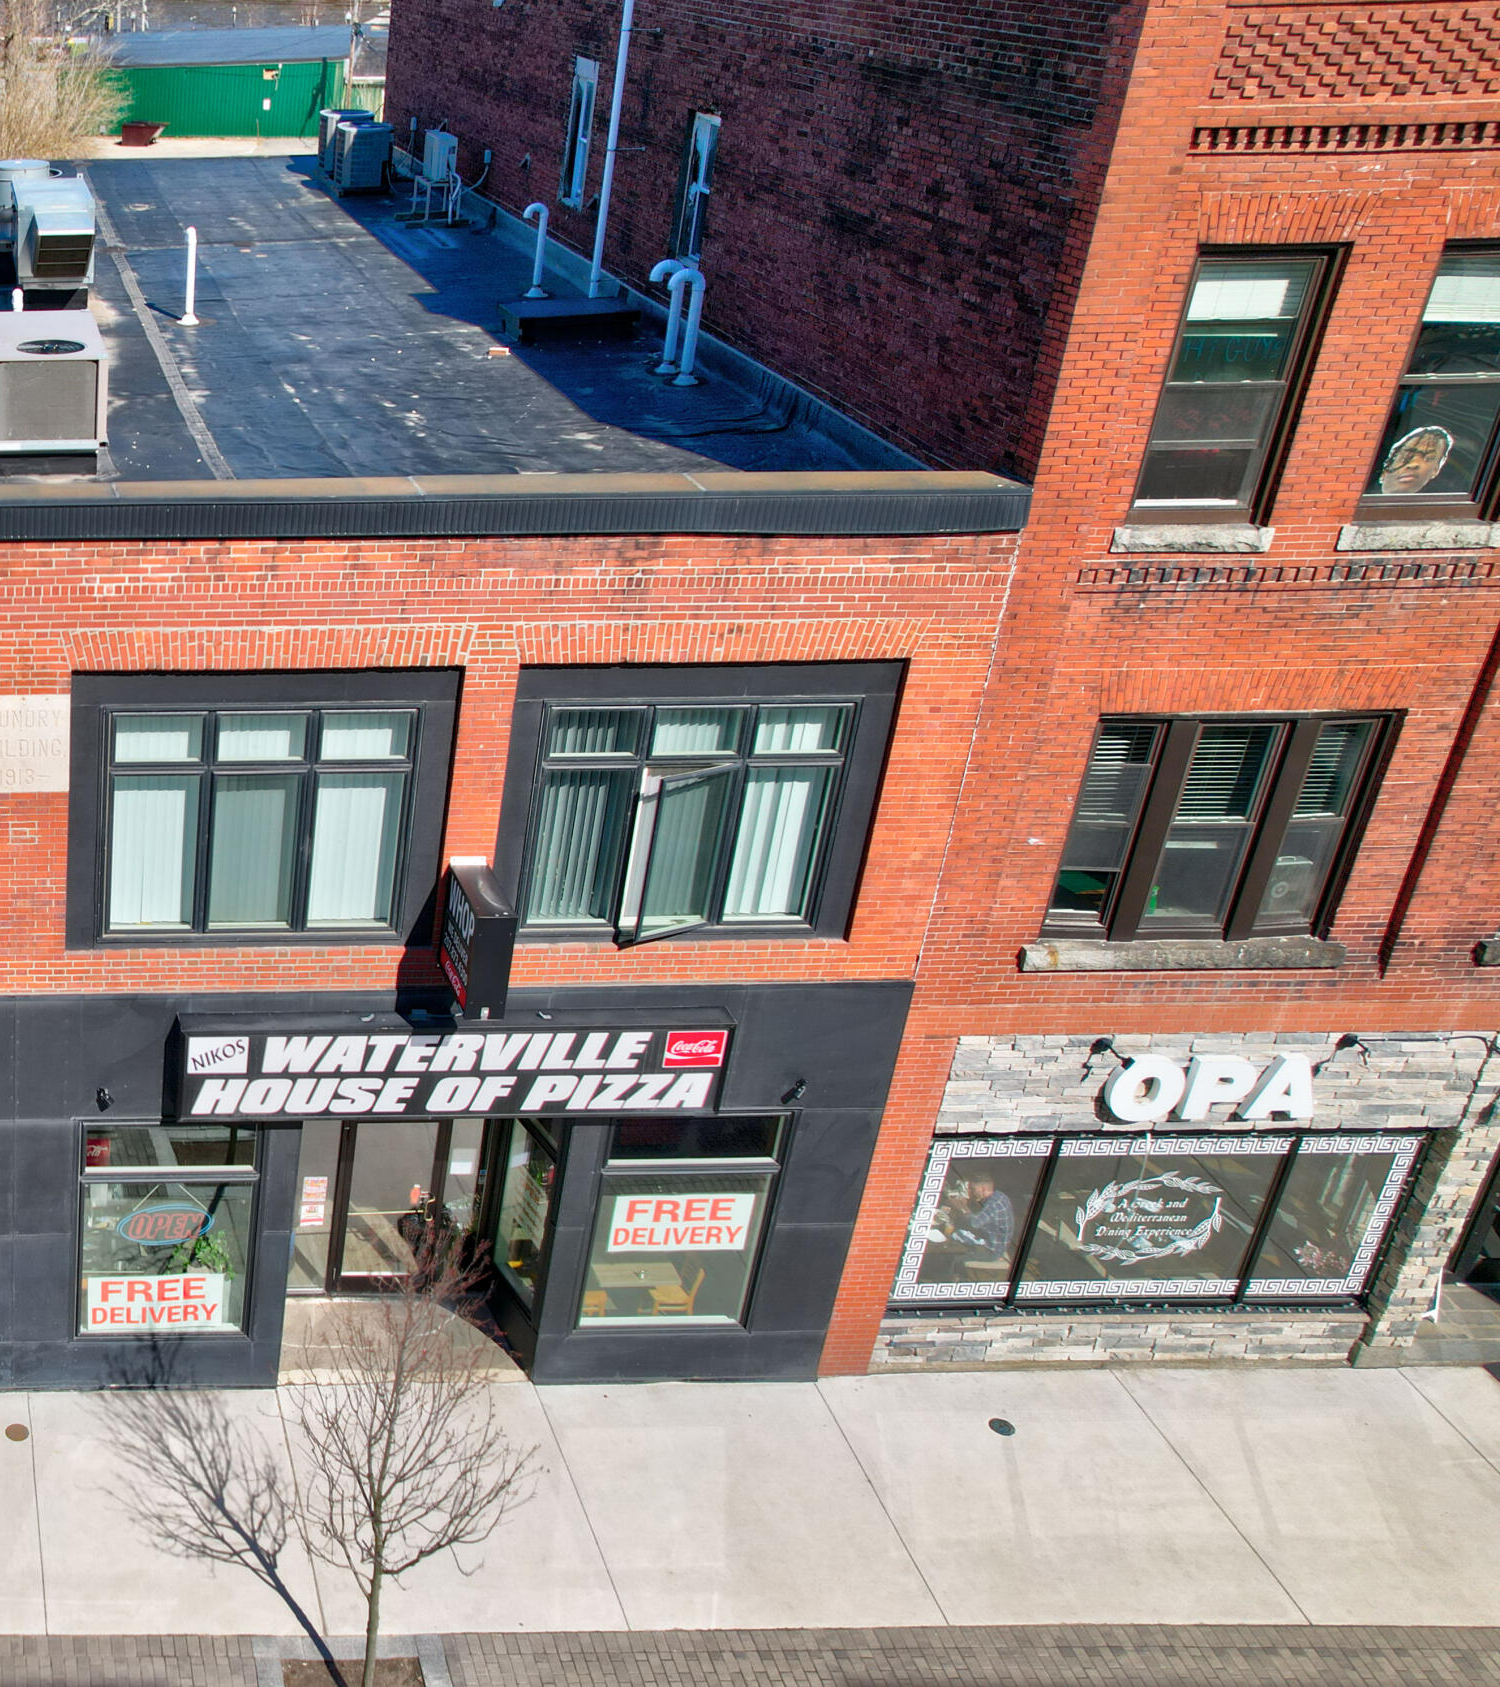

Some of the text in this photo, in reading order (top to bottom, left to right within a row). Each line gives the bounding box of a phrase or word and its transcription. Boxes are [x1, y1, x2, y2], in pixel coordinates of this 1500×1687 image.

[449, 876, 475, 945] WHOP
[191, 1039, 246, 1071] NIKOS
[261, 1032, 654, 1074] WATERVILLE
[190, 1073, 714, 1115] HOUSE OF PIZZA
[1104, 1053, 1314, 1122] OPA
[625, 1198, 736, 1223] FREE
[1165, 1197, 1189, 1208] and
[128, 1212, 206, 1240] OPEN
[1110, 1212, 1188, 1223] Mediterranean
[612, 1226, 743, 1246] DELIVERY
[1094, 1225, 1193, 1239] Dining Experience
[100, 1277, 207, 1303] FREE
[91, 1303, 218, 1325] DELIVERY
